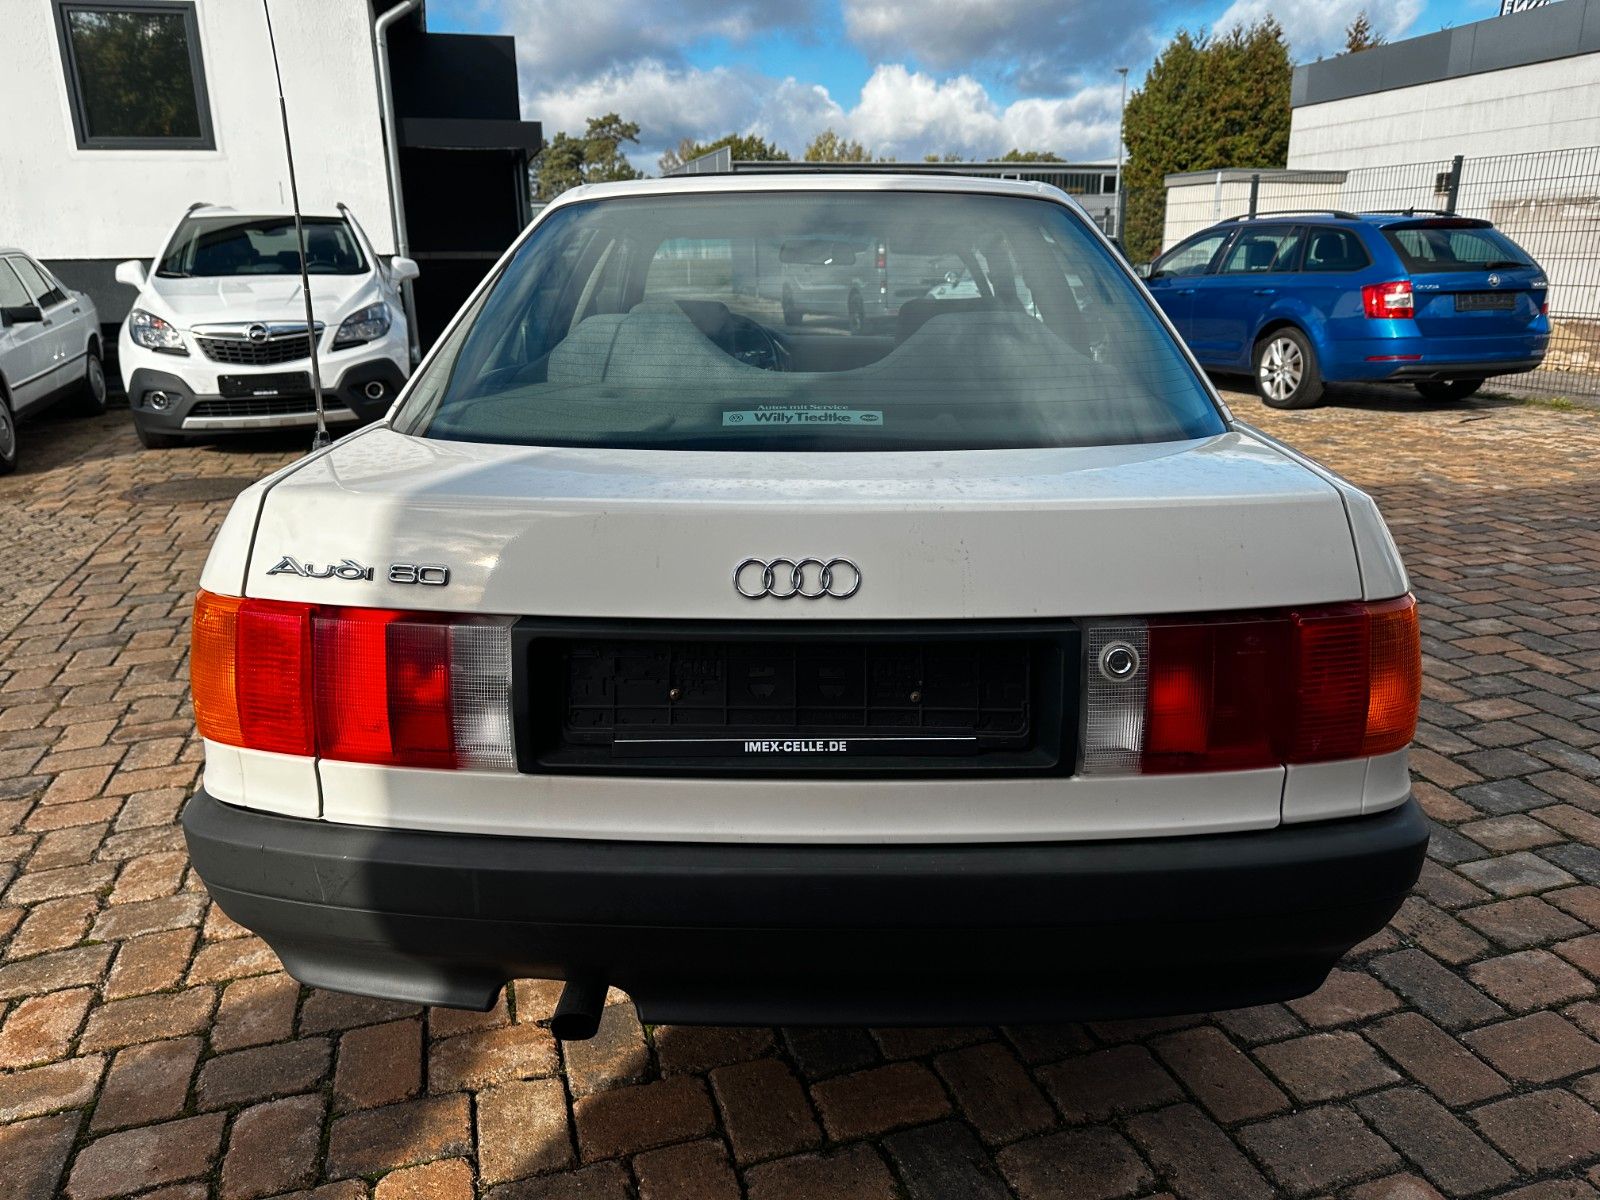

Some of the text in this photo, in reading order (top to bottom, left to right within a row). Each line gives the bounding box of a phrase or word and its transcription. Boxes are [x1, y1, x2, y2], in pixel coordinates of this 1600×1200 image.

[754, 412, 794, 424] Willy
[795, 412, 852, 422] Tiedtke
[266, 556, 450, 586] Audi 80
[744, 741, 847, 752] IMEX-CELLE.DE
